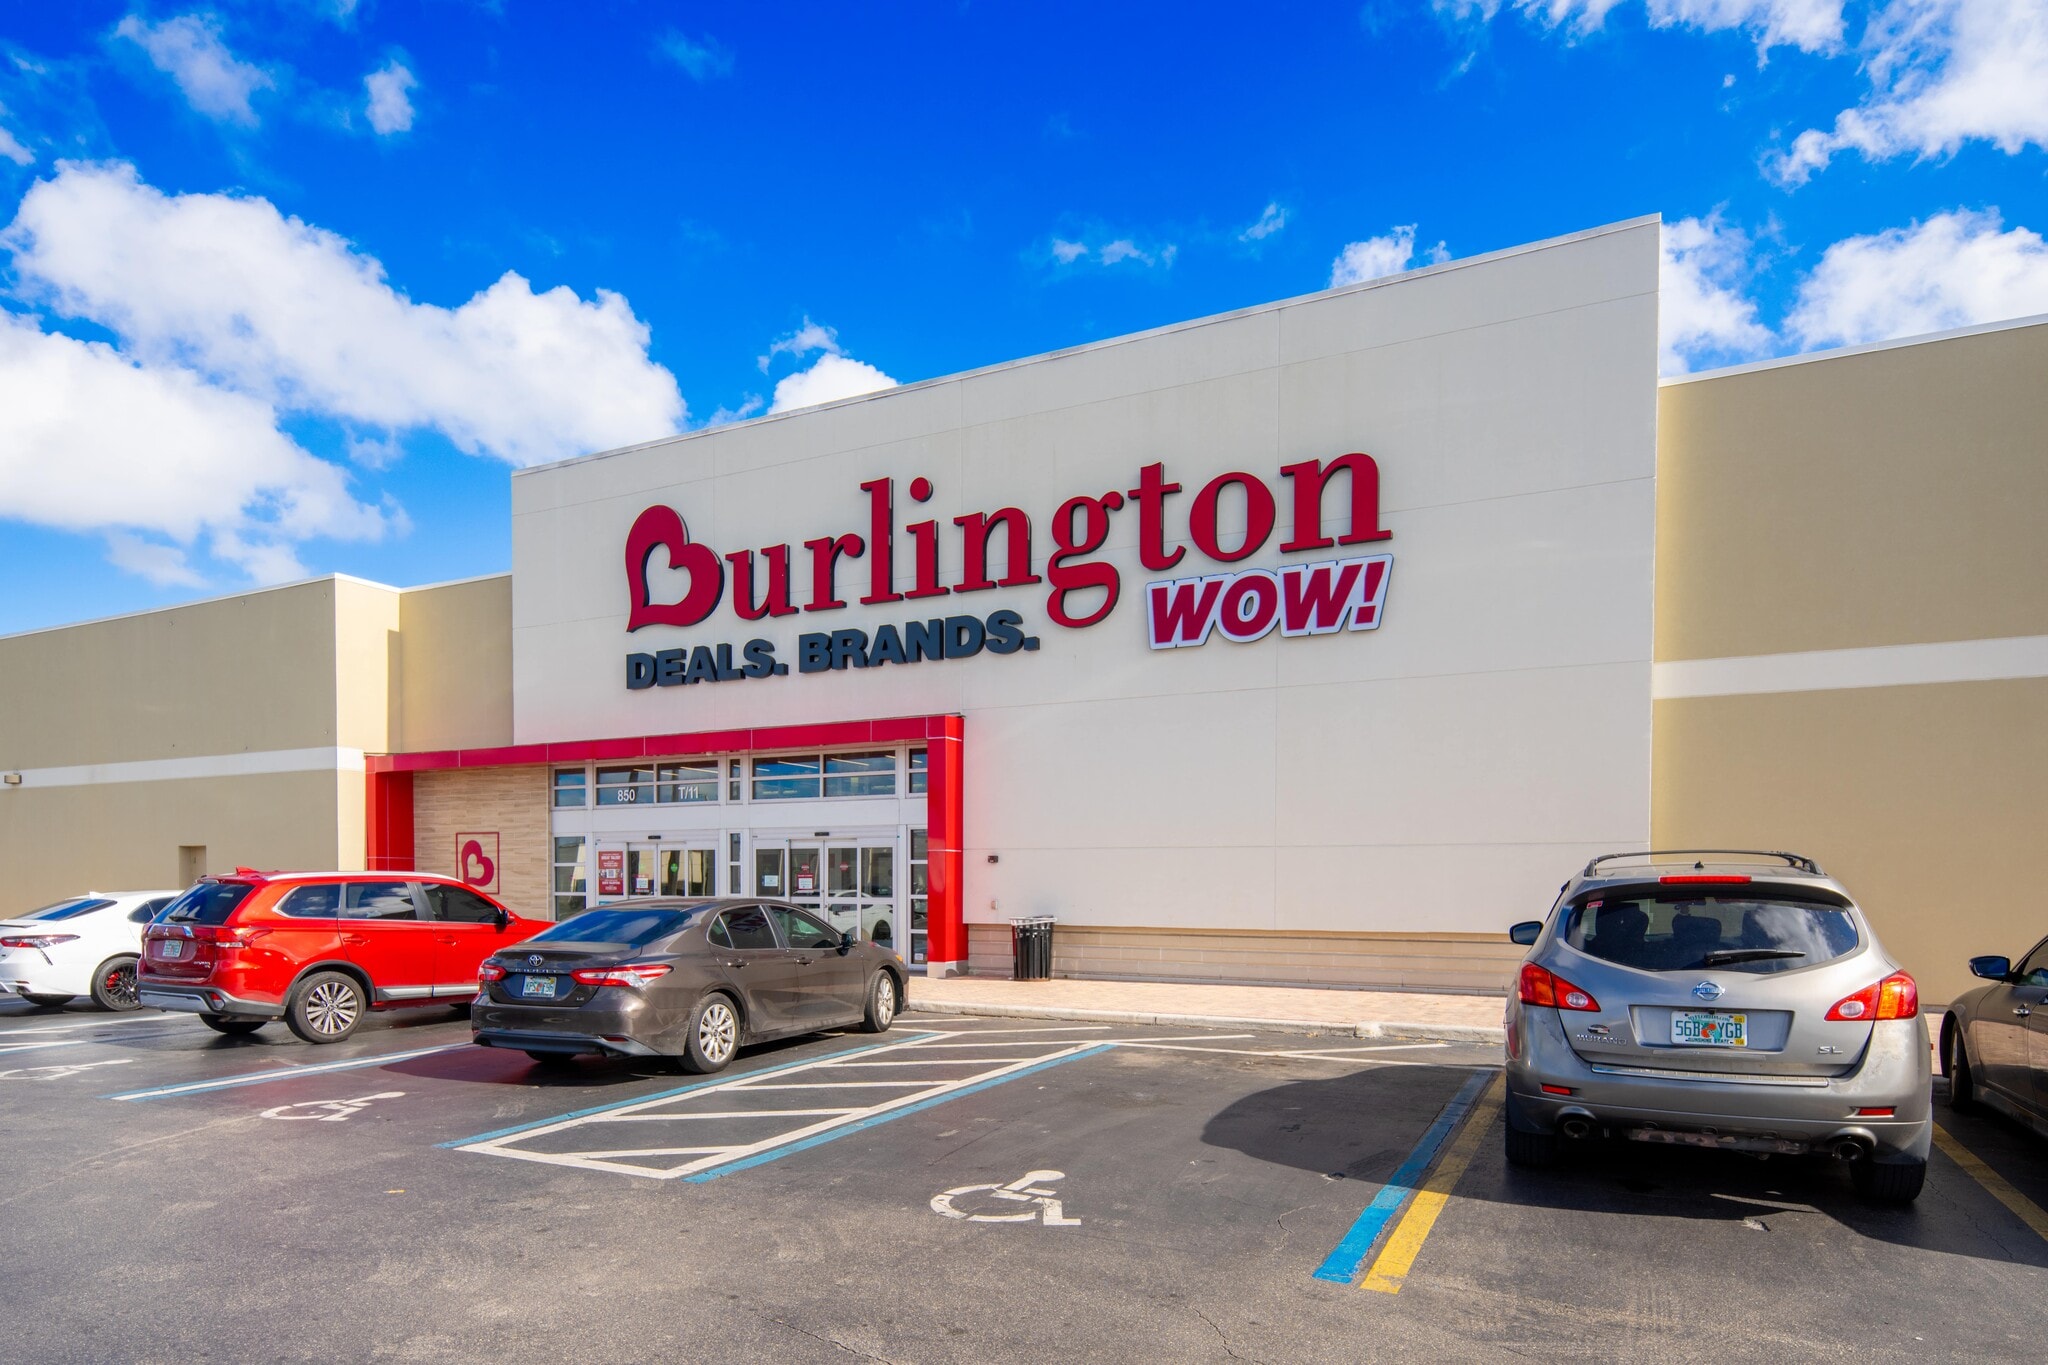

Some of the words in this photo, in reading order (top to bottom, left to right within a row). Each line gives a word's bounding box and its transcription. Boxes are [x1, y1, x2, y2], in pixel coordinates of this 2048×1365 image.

[625, 453, 1393, 632] Burlington
[626, 638, 788, 690] DEALS.
[799, 610, 1040, 673] BRANDS.
[1149, 558, 1388, 646] WOW!
[617, 789, 636, 802] 850
[678, 786, 699, 800] T/11
[1675, 1021, 1701, 1037] 56B
[1717, 1022, 1743, 1039] YGB
[1818, 1046, 1844, 1055] SL
